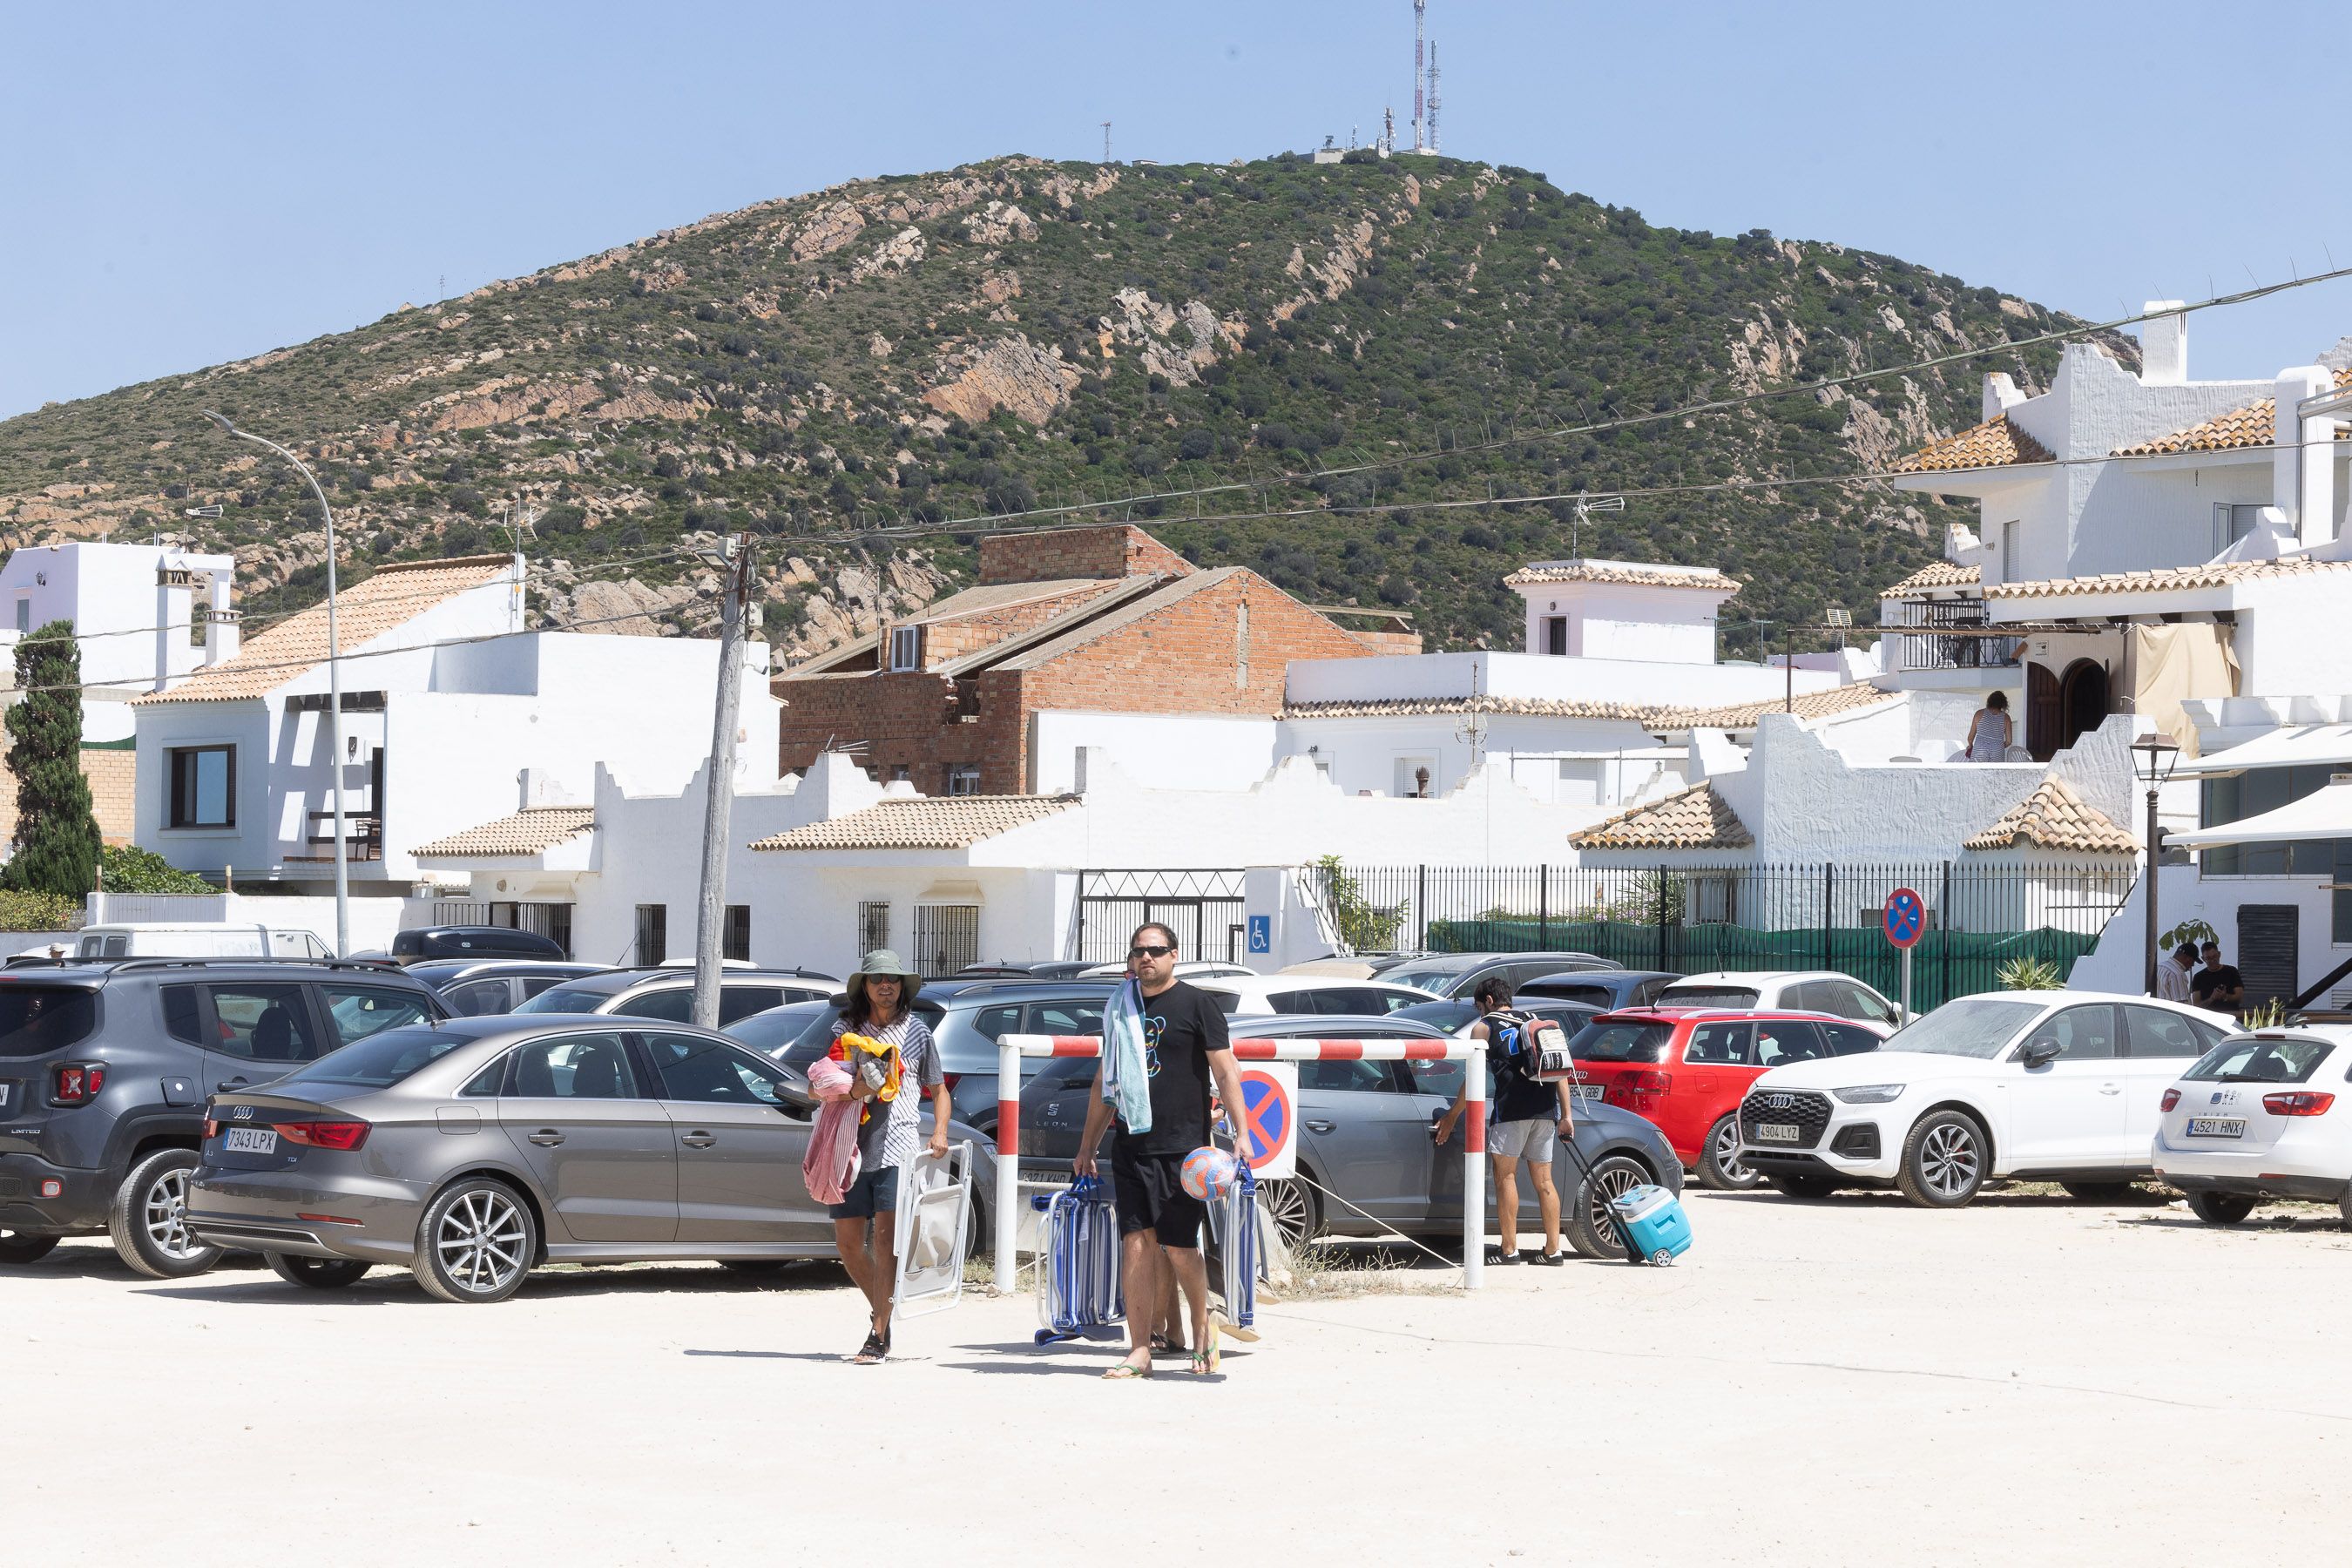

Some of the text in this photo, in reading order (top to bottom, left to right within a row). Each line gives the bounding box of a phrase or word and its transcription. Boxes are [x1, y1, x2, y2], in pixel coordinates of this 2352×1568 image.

[1498, 1027, 1519, 1056] 7
[1761, 1125, 1797, 1139] 4904 LYZ
[2193, 1121, 2240, 1134] 4521 HNX
[228, 1131, 274, 1151] 7343 LPX
